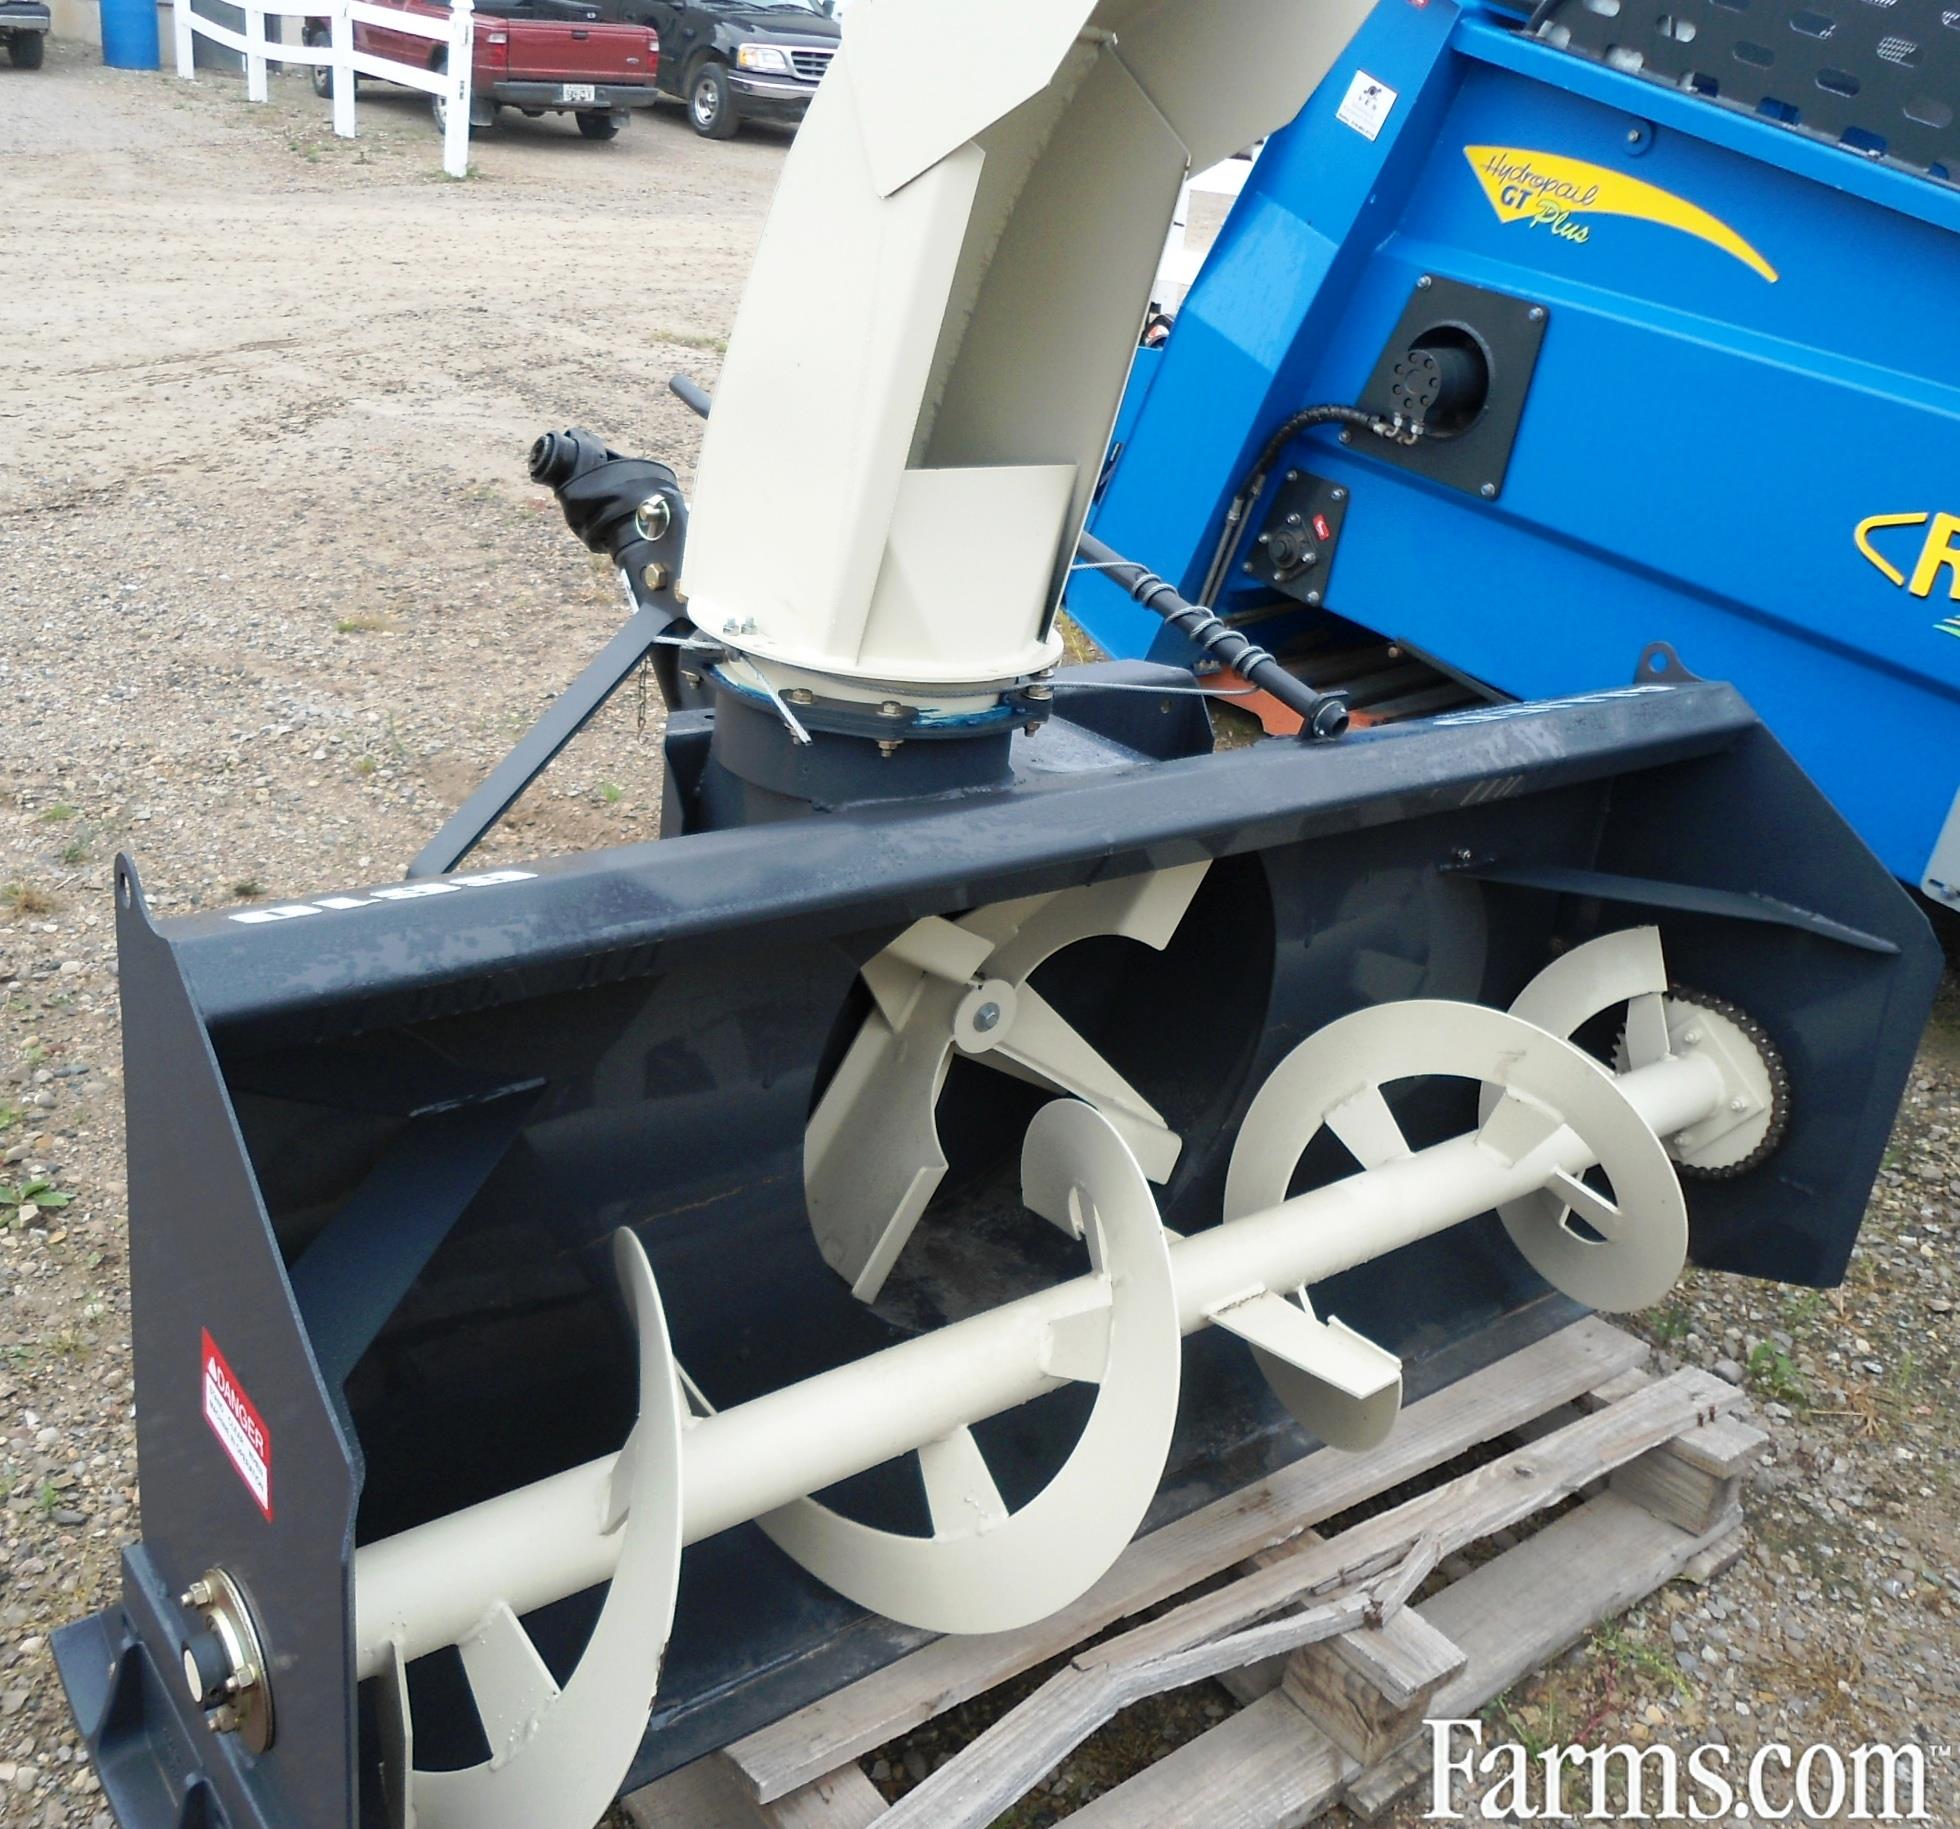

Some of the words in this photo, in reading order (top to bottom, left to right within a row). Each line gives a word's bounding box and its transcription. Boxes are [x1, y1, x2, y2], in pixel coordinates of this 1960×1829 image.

[1481, 152, 1599, 206] Hydropail
[1501, 184, 1532, 209] GT
[1529, 198, 1590, 243] Plus
[216, 1366, 264, 1458] DANGER
